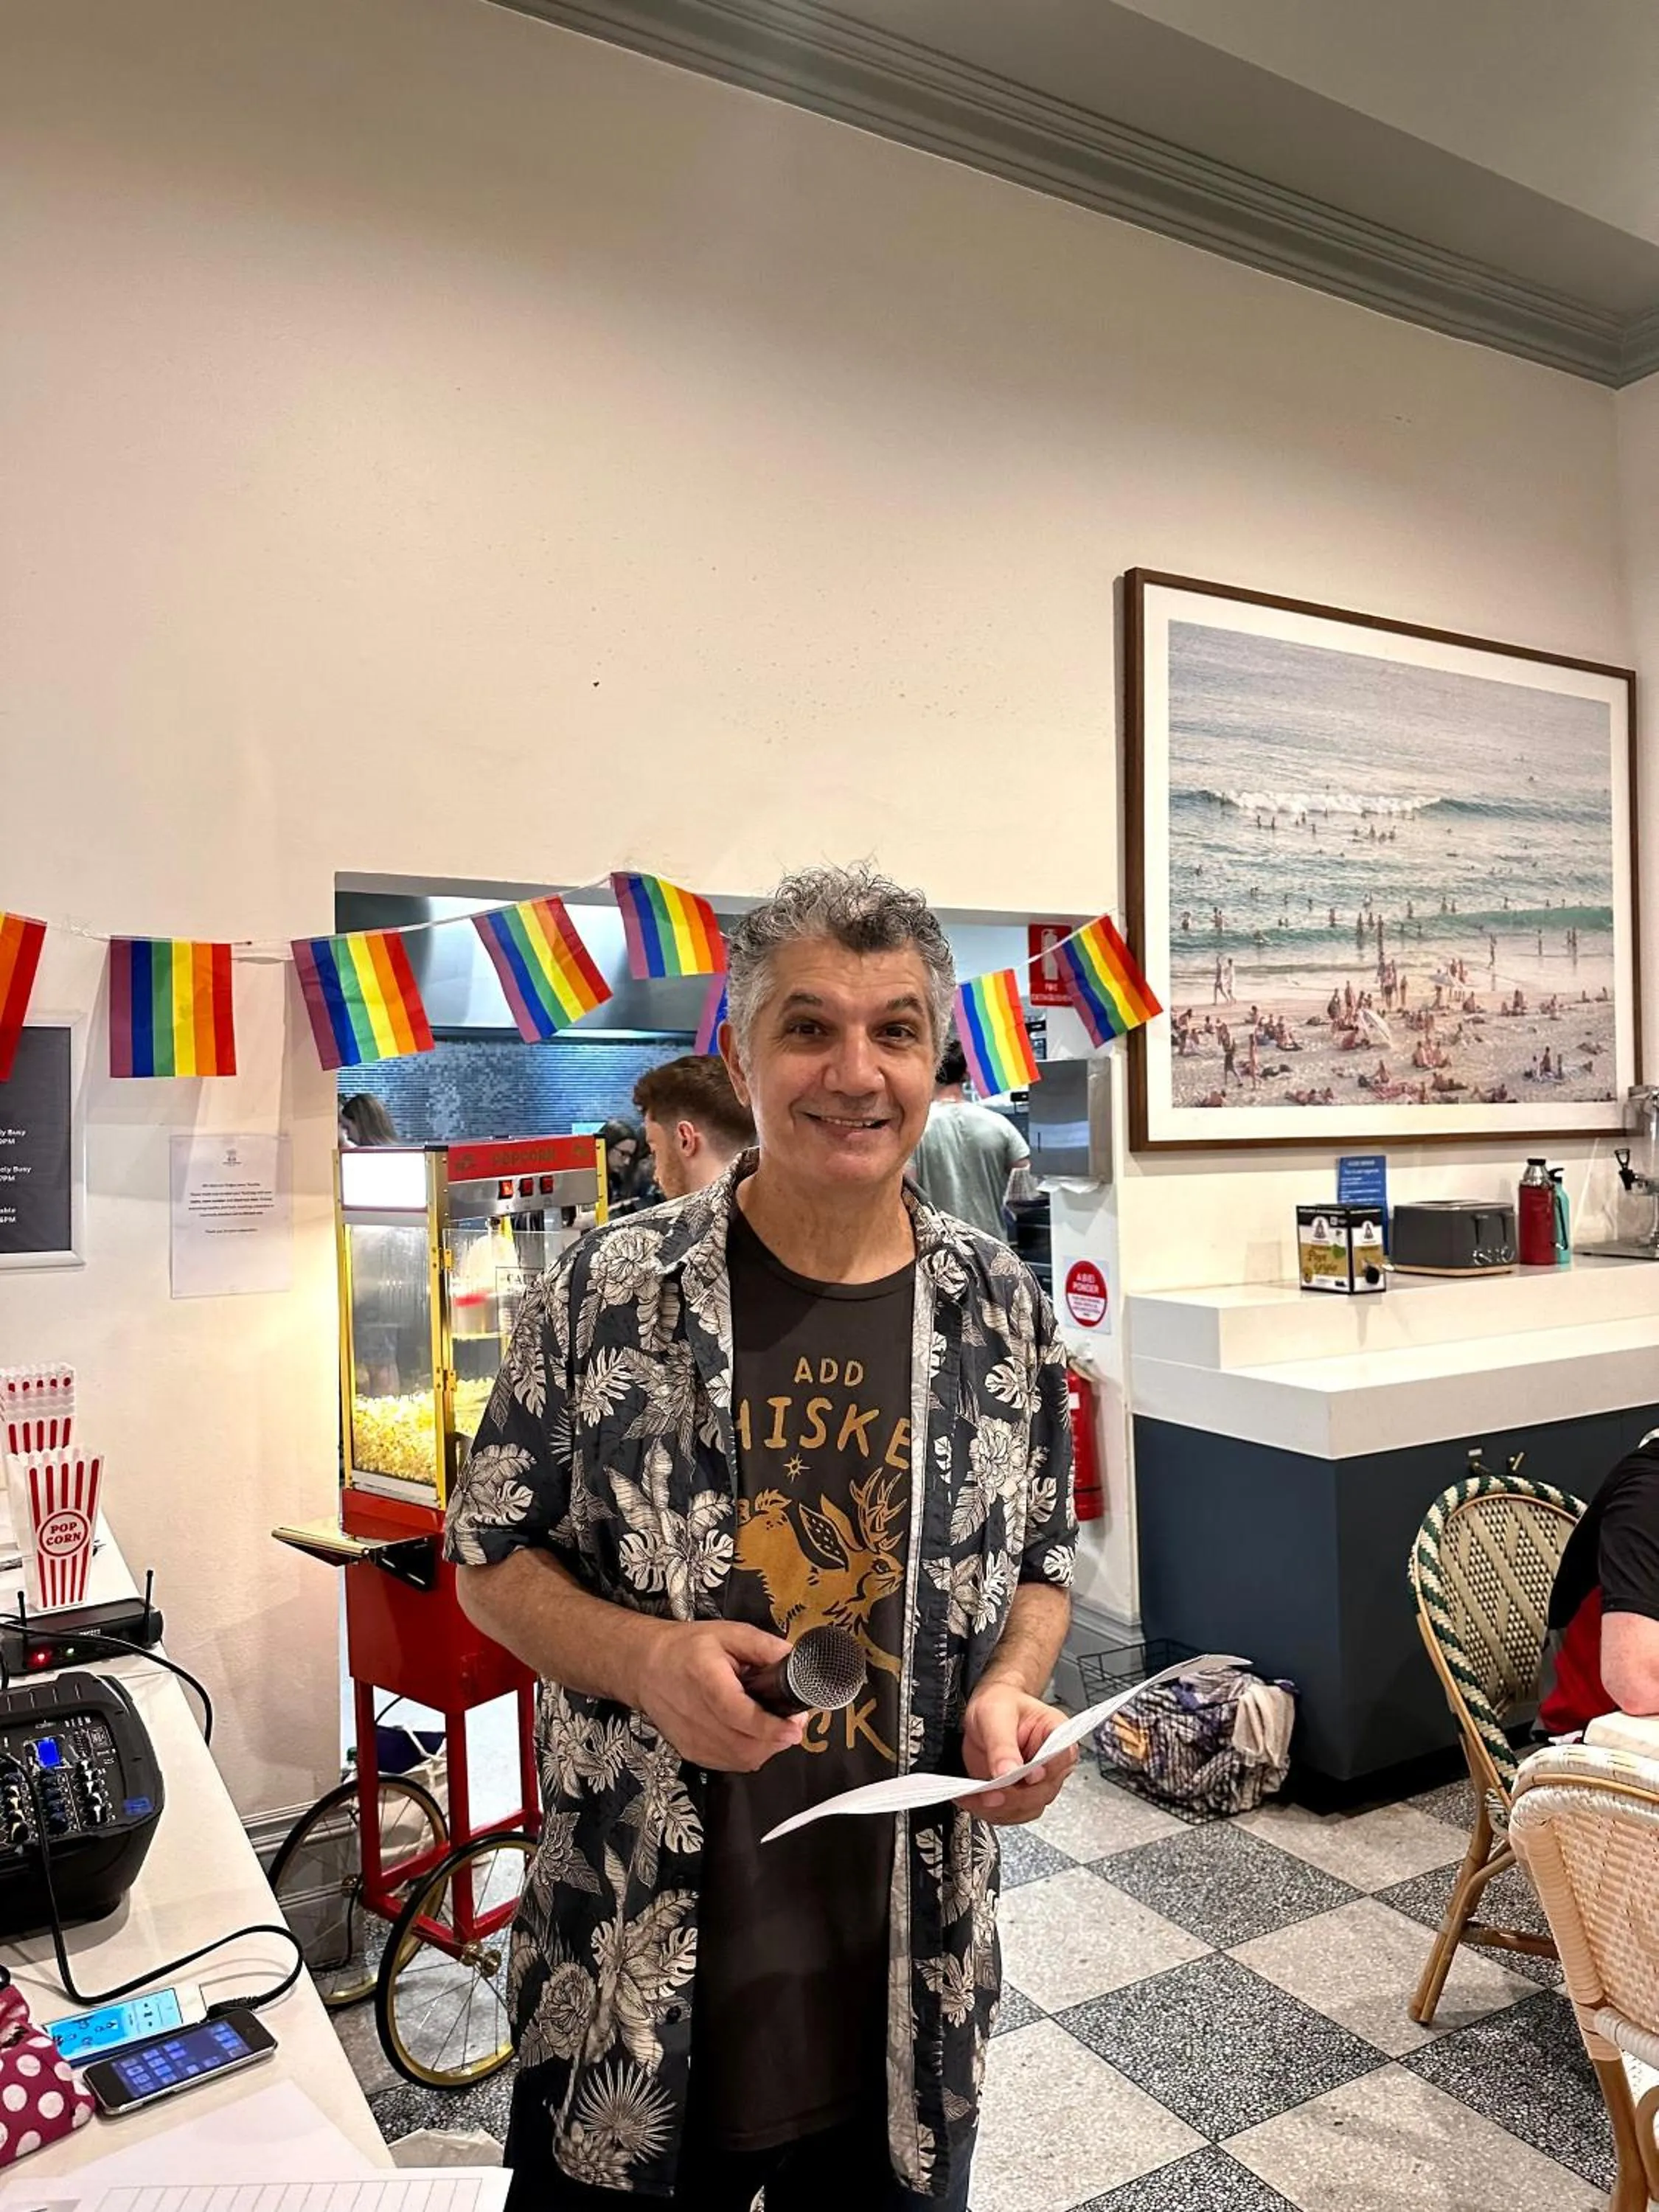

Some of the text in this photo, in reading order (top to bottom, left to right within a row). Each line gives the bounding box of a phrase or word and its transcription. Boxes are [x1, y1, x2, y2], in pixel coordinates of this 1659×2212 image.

[794, 1356, 864, 1387] ADD
[50, 1521, 77, 1534] POP
[46, 1532, 81, 1546] CORN
